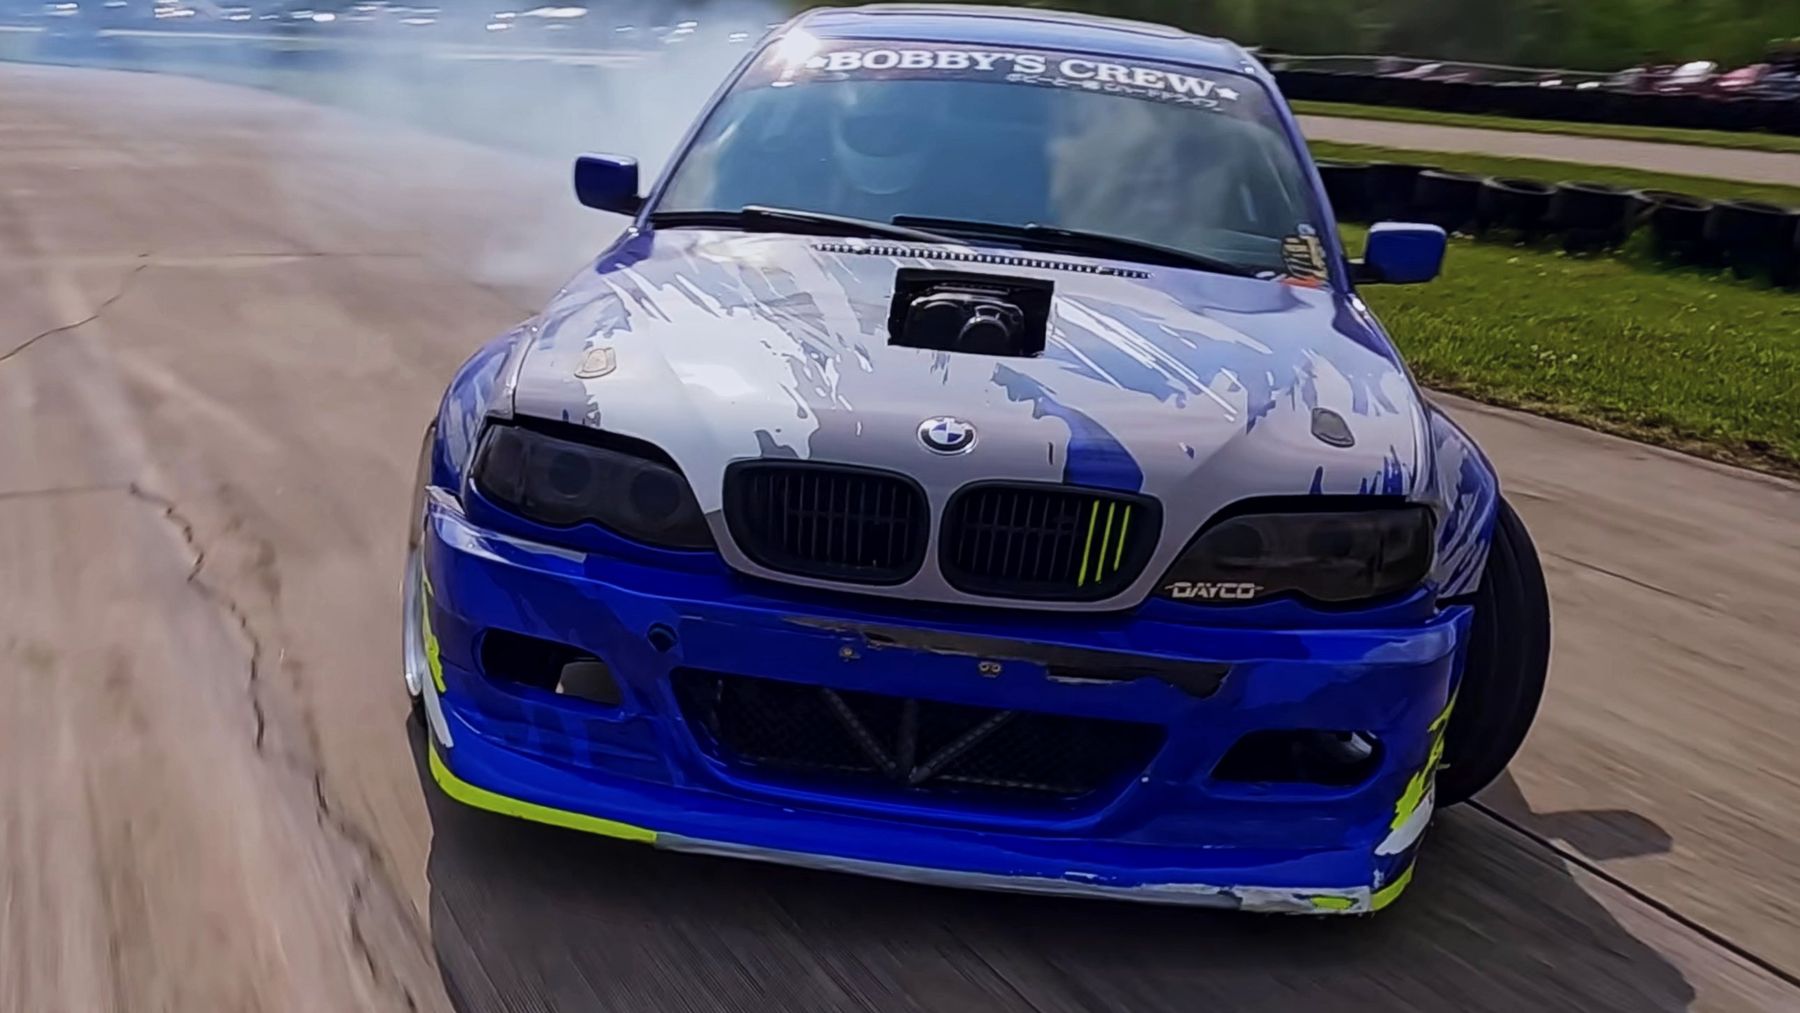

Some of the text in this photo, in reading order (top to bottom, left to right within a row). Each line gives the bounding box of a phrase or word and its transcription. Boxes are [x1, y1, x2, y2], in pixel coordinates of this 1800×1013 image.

[824, 49, 1047, 74] BOBBY'S
[1059, 58, 1217, 97] CREW
[1170, 581, 1256, 599] DAYCO
